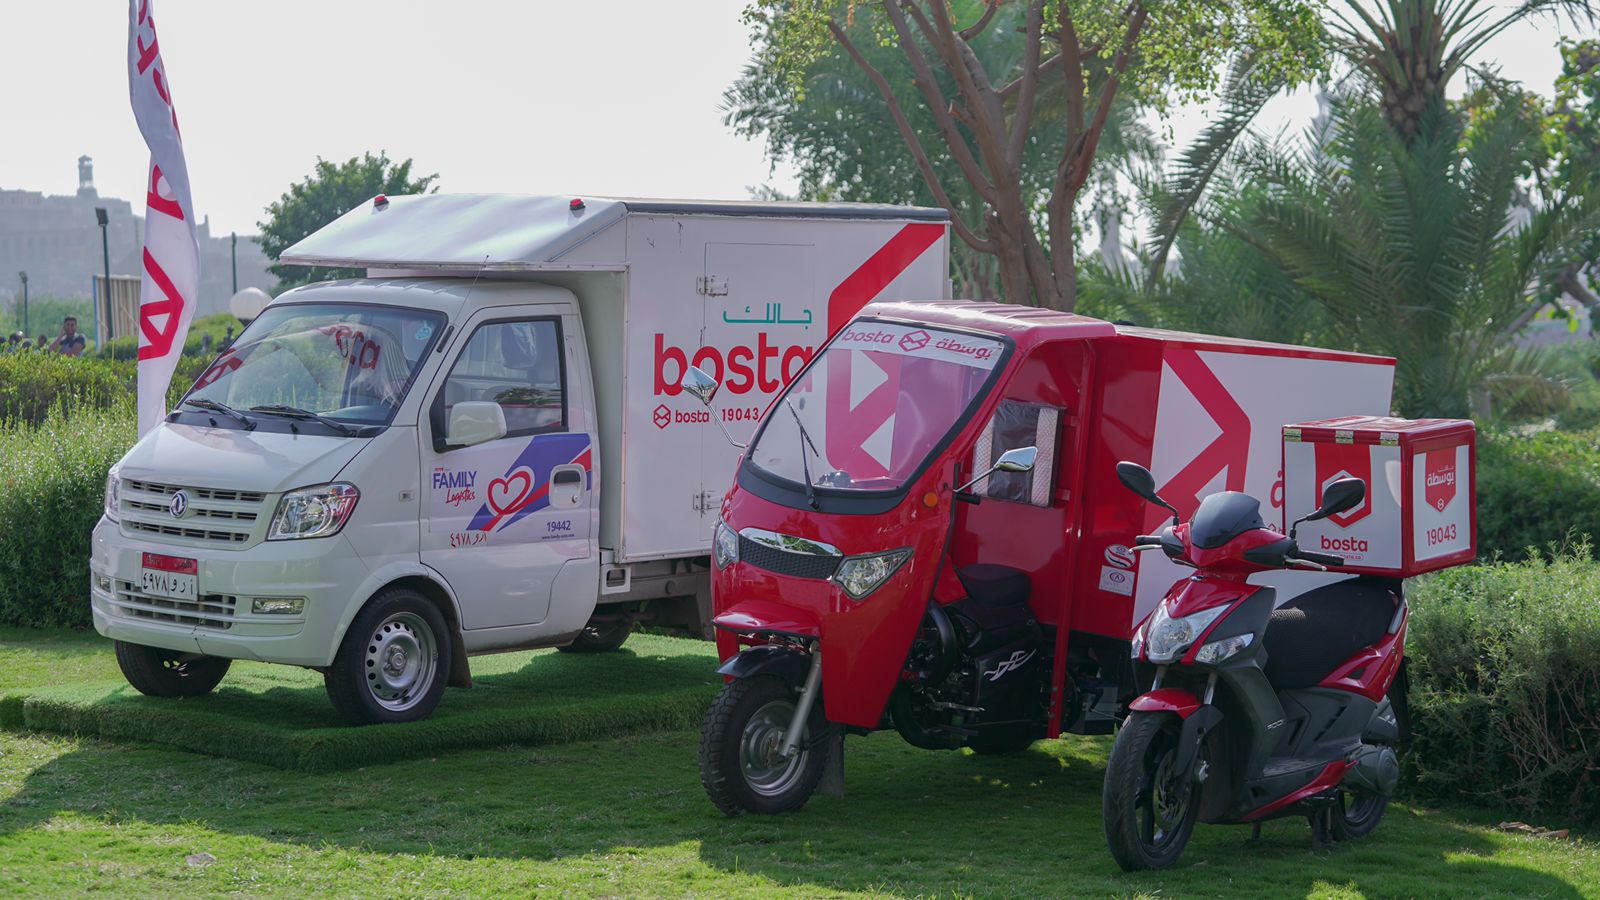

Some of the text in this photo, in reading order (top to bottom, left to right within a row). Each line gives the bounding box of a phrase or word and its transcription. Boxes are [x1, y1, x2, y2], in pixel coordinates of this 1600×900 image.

[723, 303, 813, 330] جالك
[842, 329, 896, 344] bosta
[936, 338, 993, 360] بوسطة
[654, 332, 813, 396] bosta
[675, 407, 760, 423] bosta 19043
[433, 471, 478, 489] FAMILY
[1427, 472, 1455, 487] بوسطة
[445, 488, 477, 506] Logistics
[546, 520, 571, 532] 19442
[1426, 524, 1457, 546] 19043
[1321, 535, 1368, 552] bosta
[143, 572, 168, 592] ٤٩٧٨
